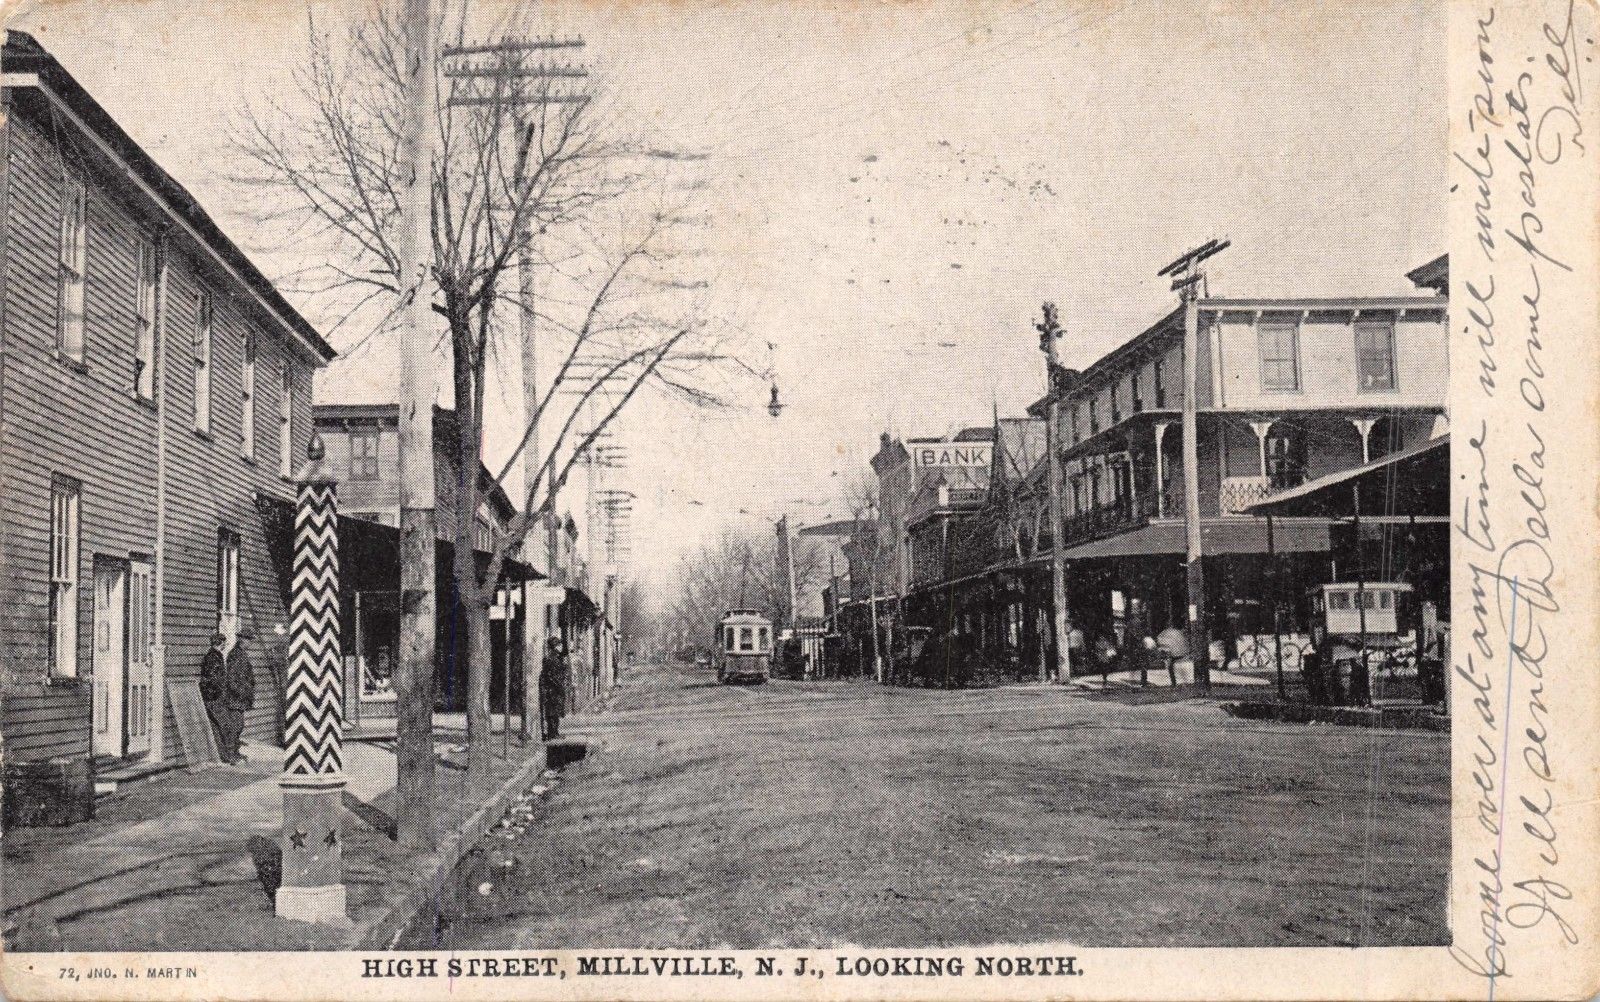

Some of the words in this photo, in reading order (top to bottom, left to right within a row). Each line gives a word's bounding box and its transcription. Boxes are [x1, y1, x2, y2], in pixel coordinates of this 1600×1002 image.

[921, 449, 986, 465] BANK
[1454, 420, 1490, 553] time
[1456, 654, 1495, 728] at
[1509, 601, 1556, 782] send
[1475, 736, 1498, 835] over
[1448, 850, 1512, 978] Come
